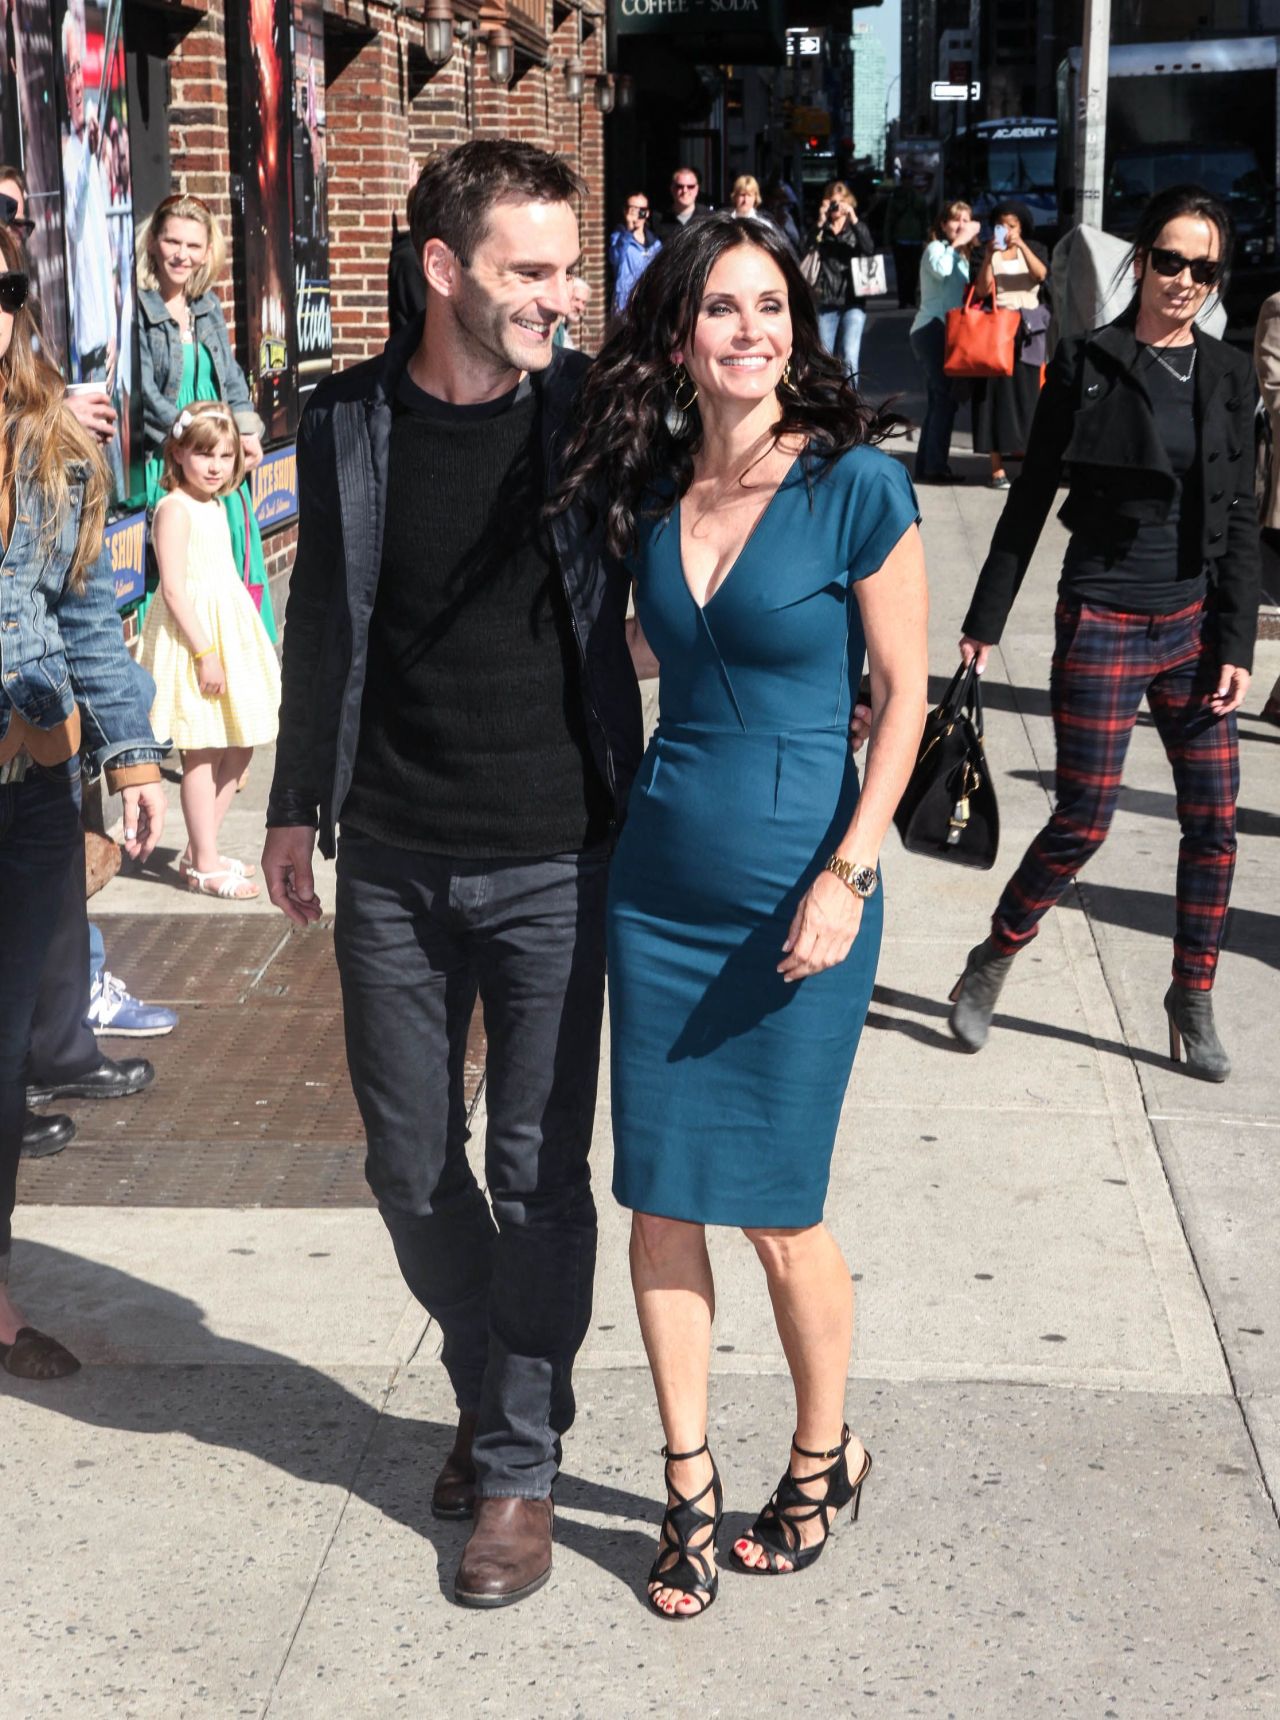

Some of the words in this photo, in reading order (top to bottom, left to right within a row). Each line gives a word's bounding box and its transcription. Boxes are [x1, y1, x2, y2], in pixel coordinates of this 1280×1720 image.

[621, 0, 689, 16] COFFEE
[710, 0, 759, 13] SODA
[991, 127, 1047, 139] ACADEMY
[251, 462, 274, 513] LATE
[274, 454, 296, 497] SHOW
[111, 521, 144, 574] SHOW
